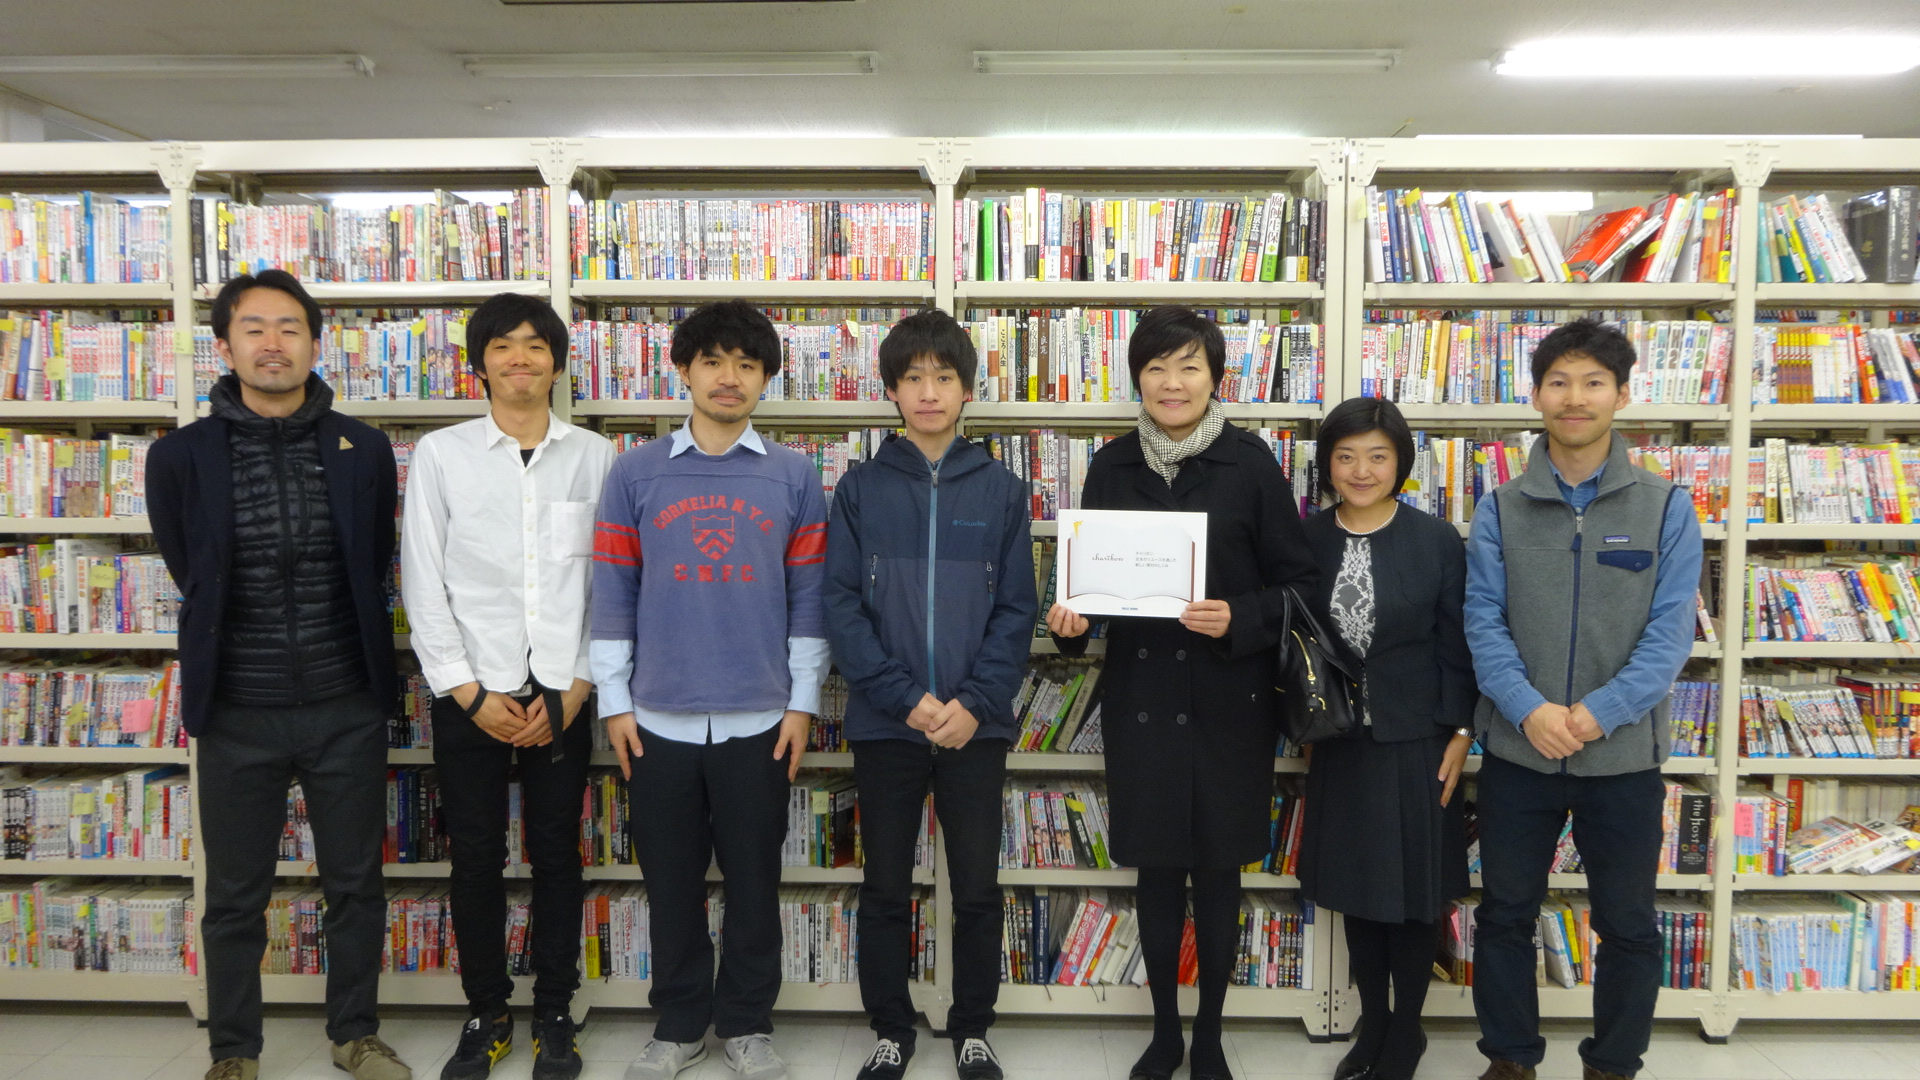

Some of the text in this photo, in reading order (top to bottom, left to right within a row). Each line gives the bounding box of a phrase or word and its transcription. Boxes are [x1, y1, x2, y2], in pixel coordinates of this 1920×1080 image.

[1013, 198, 1024, 234] 放蕩記
[653, 495, 727, 530] CORNELIA
[1689, 817, 1706, 844] host
